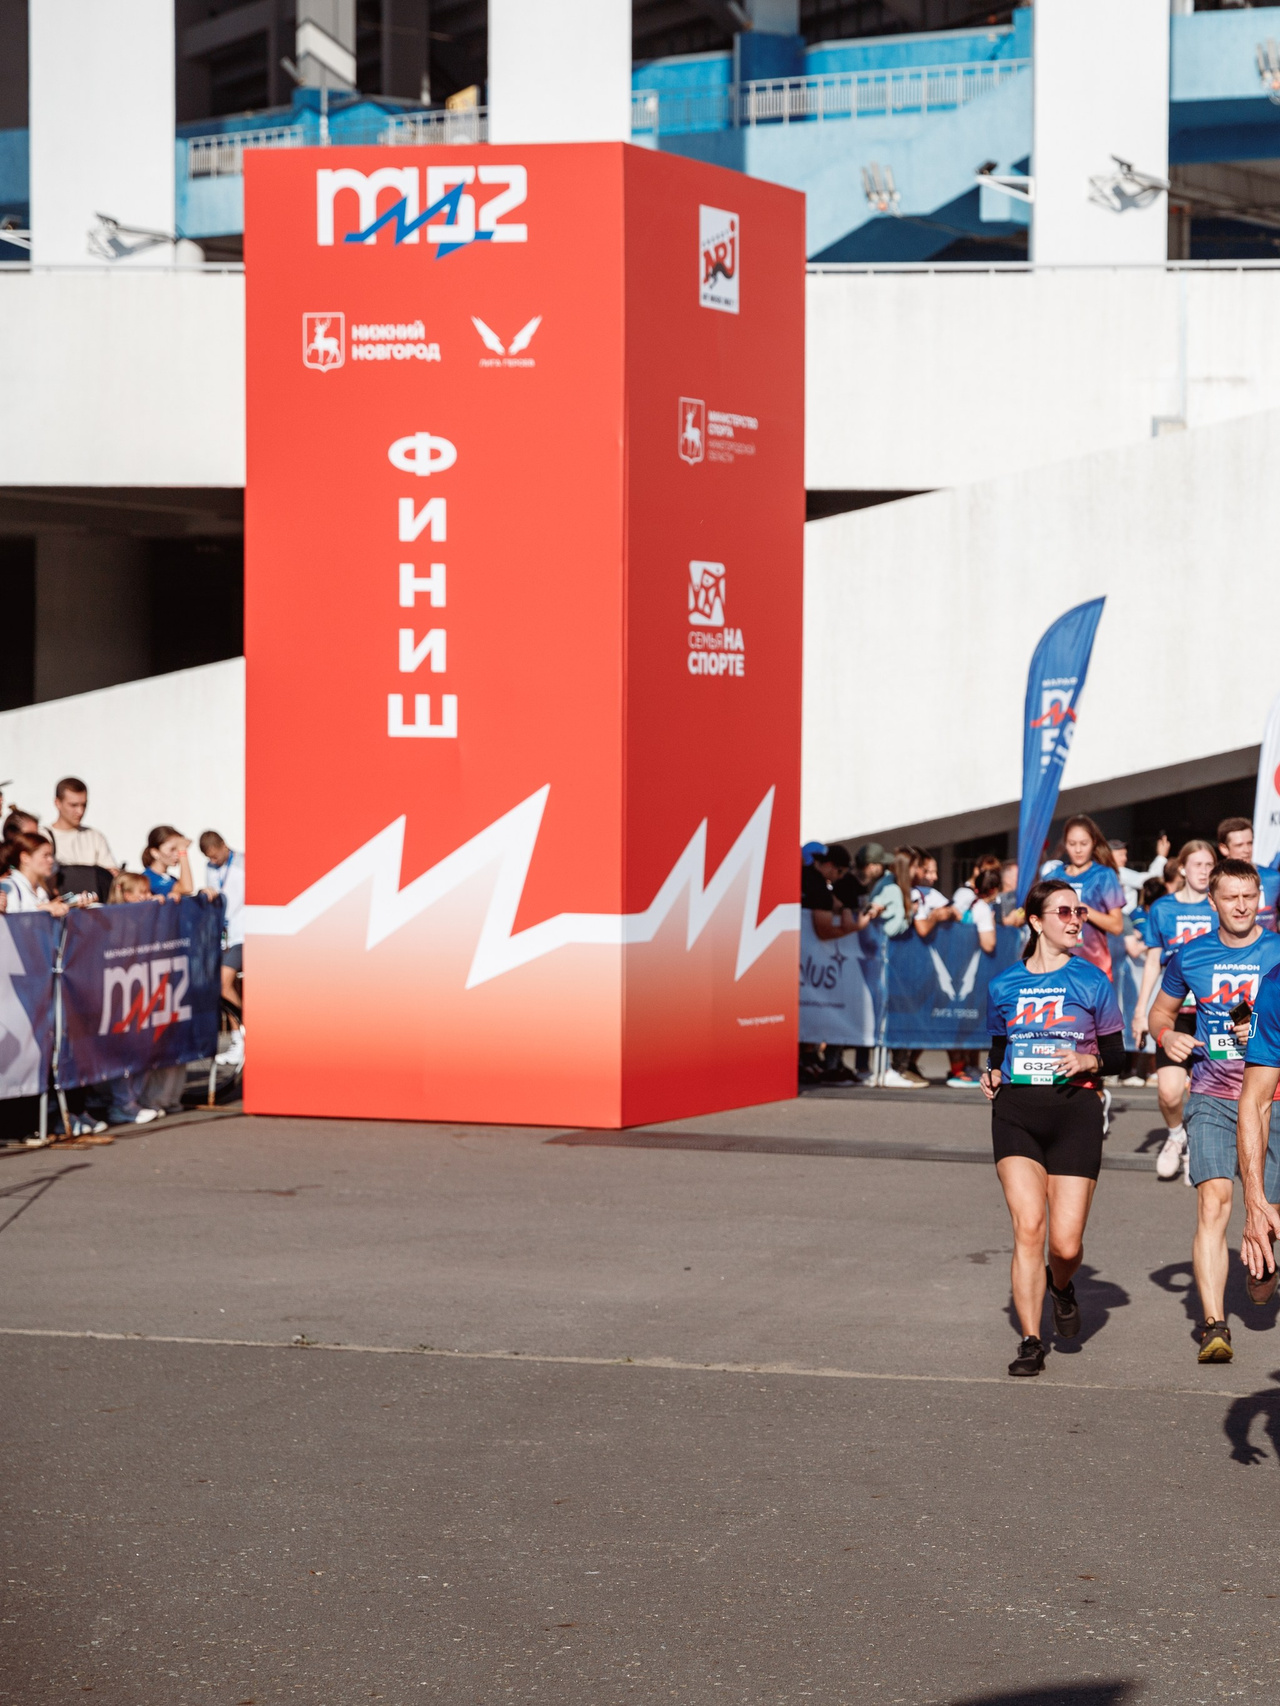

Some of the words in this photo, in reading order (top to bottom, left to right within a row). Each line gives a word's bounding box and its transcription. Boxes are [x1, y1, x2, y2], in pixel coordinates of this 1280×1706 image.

[352, 320, 425, 340] НИЖНИЙ
[352, 343, 441, 361] НОВГОРОД
[387, 432, 458, 738] ФИНИШ
[723, 627, 745, 651] НА
[687, 651, 746, 677] СПОРТЕ
[799, 955, 838, 990] lus
[1213, 963, 1260, 972] МАРАФОН
[1019, 987, 1067, 995] МАРАФОН
[1023, 1062, 1062, 1071] 632
